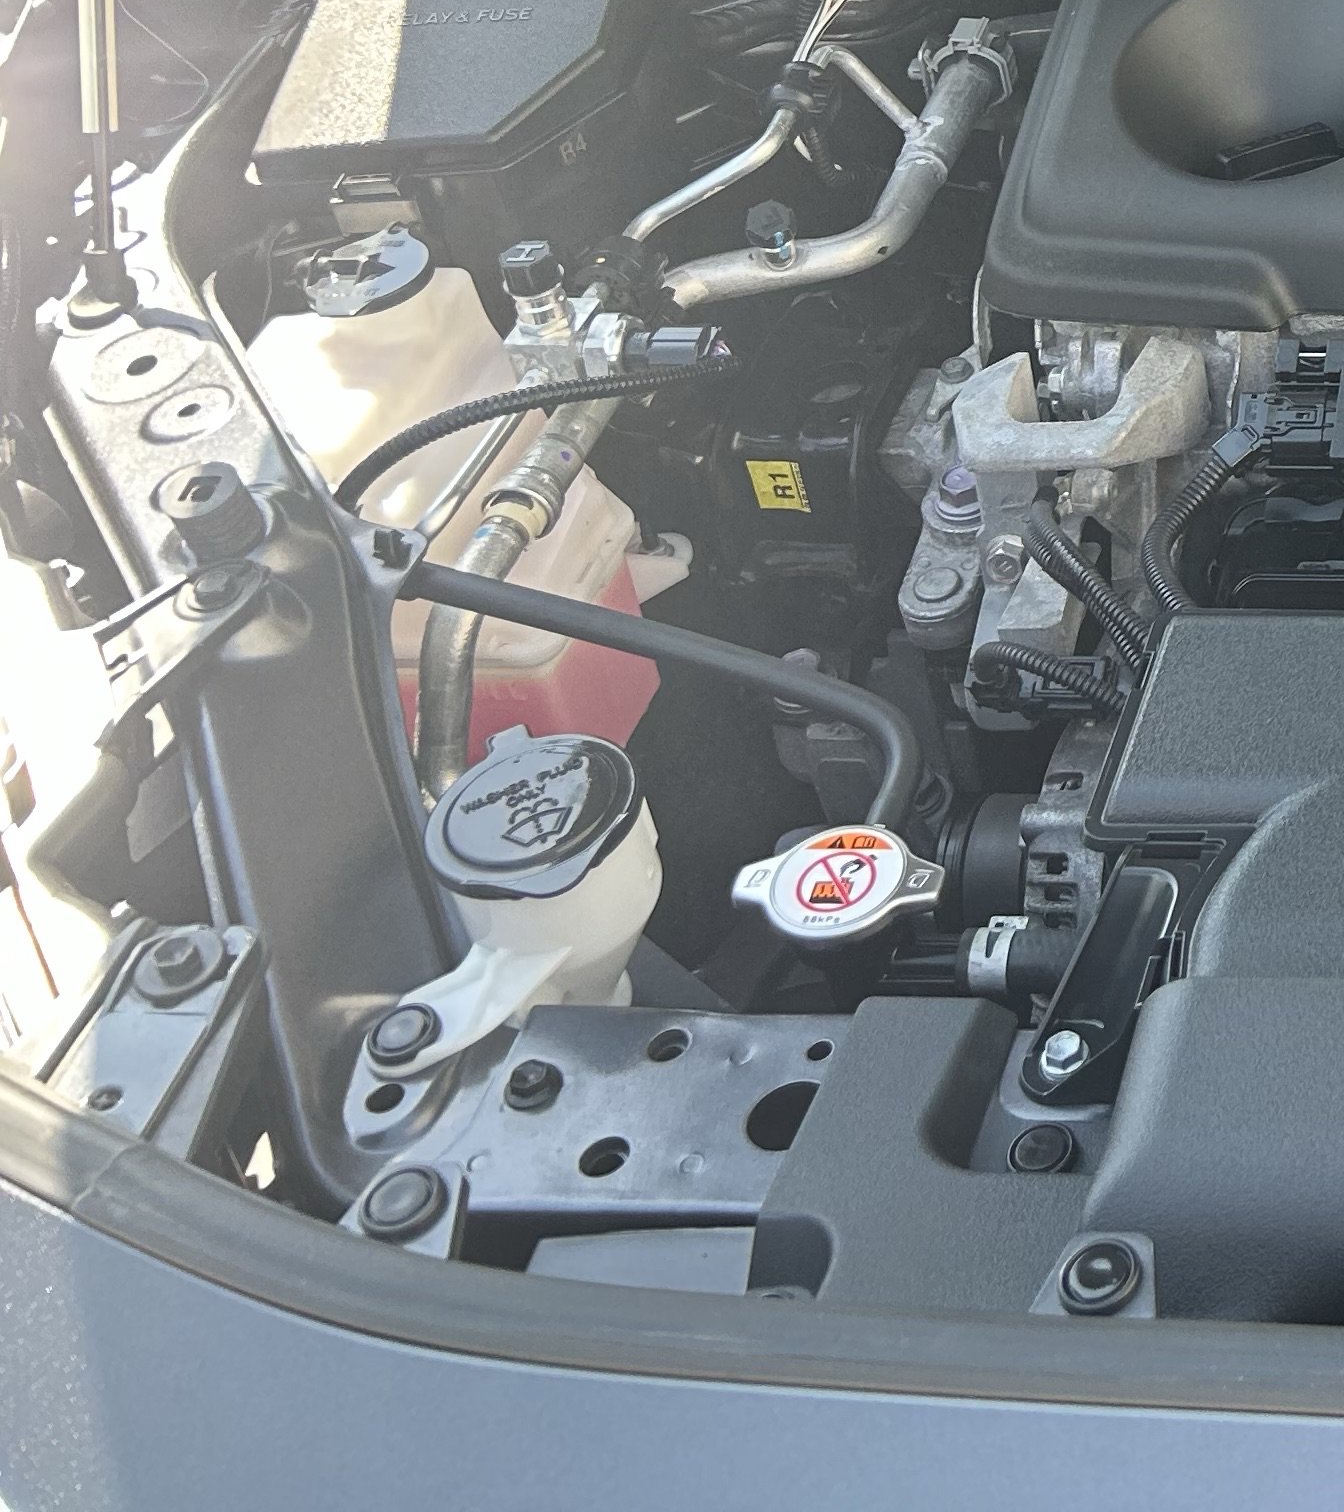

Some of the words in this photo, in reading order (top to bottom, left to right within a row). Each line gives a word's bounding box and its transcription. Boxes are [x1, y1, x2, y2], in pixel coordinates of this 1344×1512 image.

[455, 9, 471, 24] &
[475, 6, 534, 24] FUSE
[768, 473, 796, 499] R1
[461, 779, 530, 814] WASHER
[506, 783, 547, 808] ONLY
